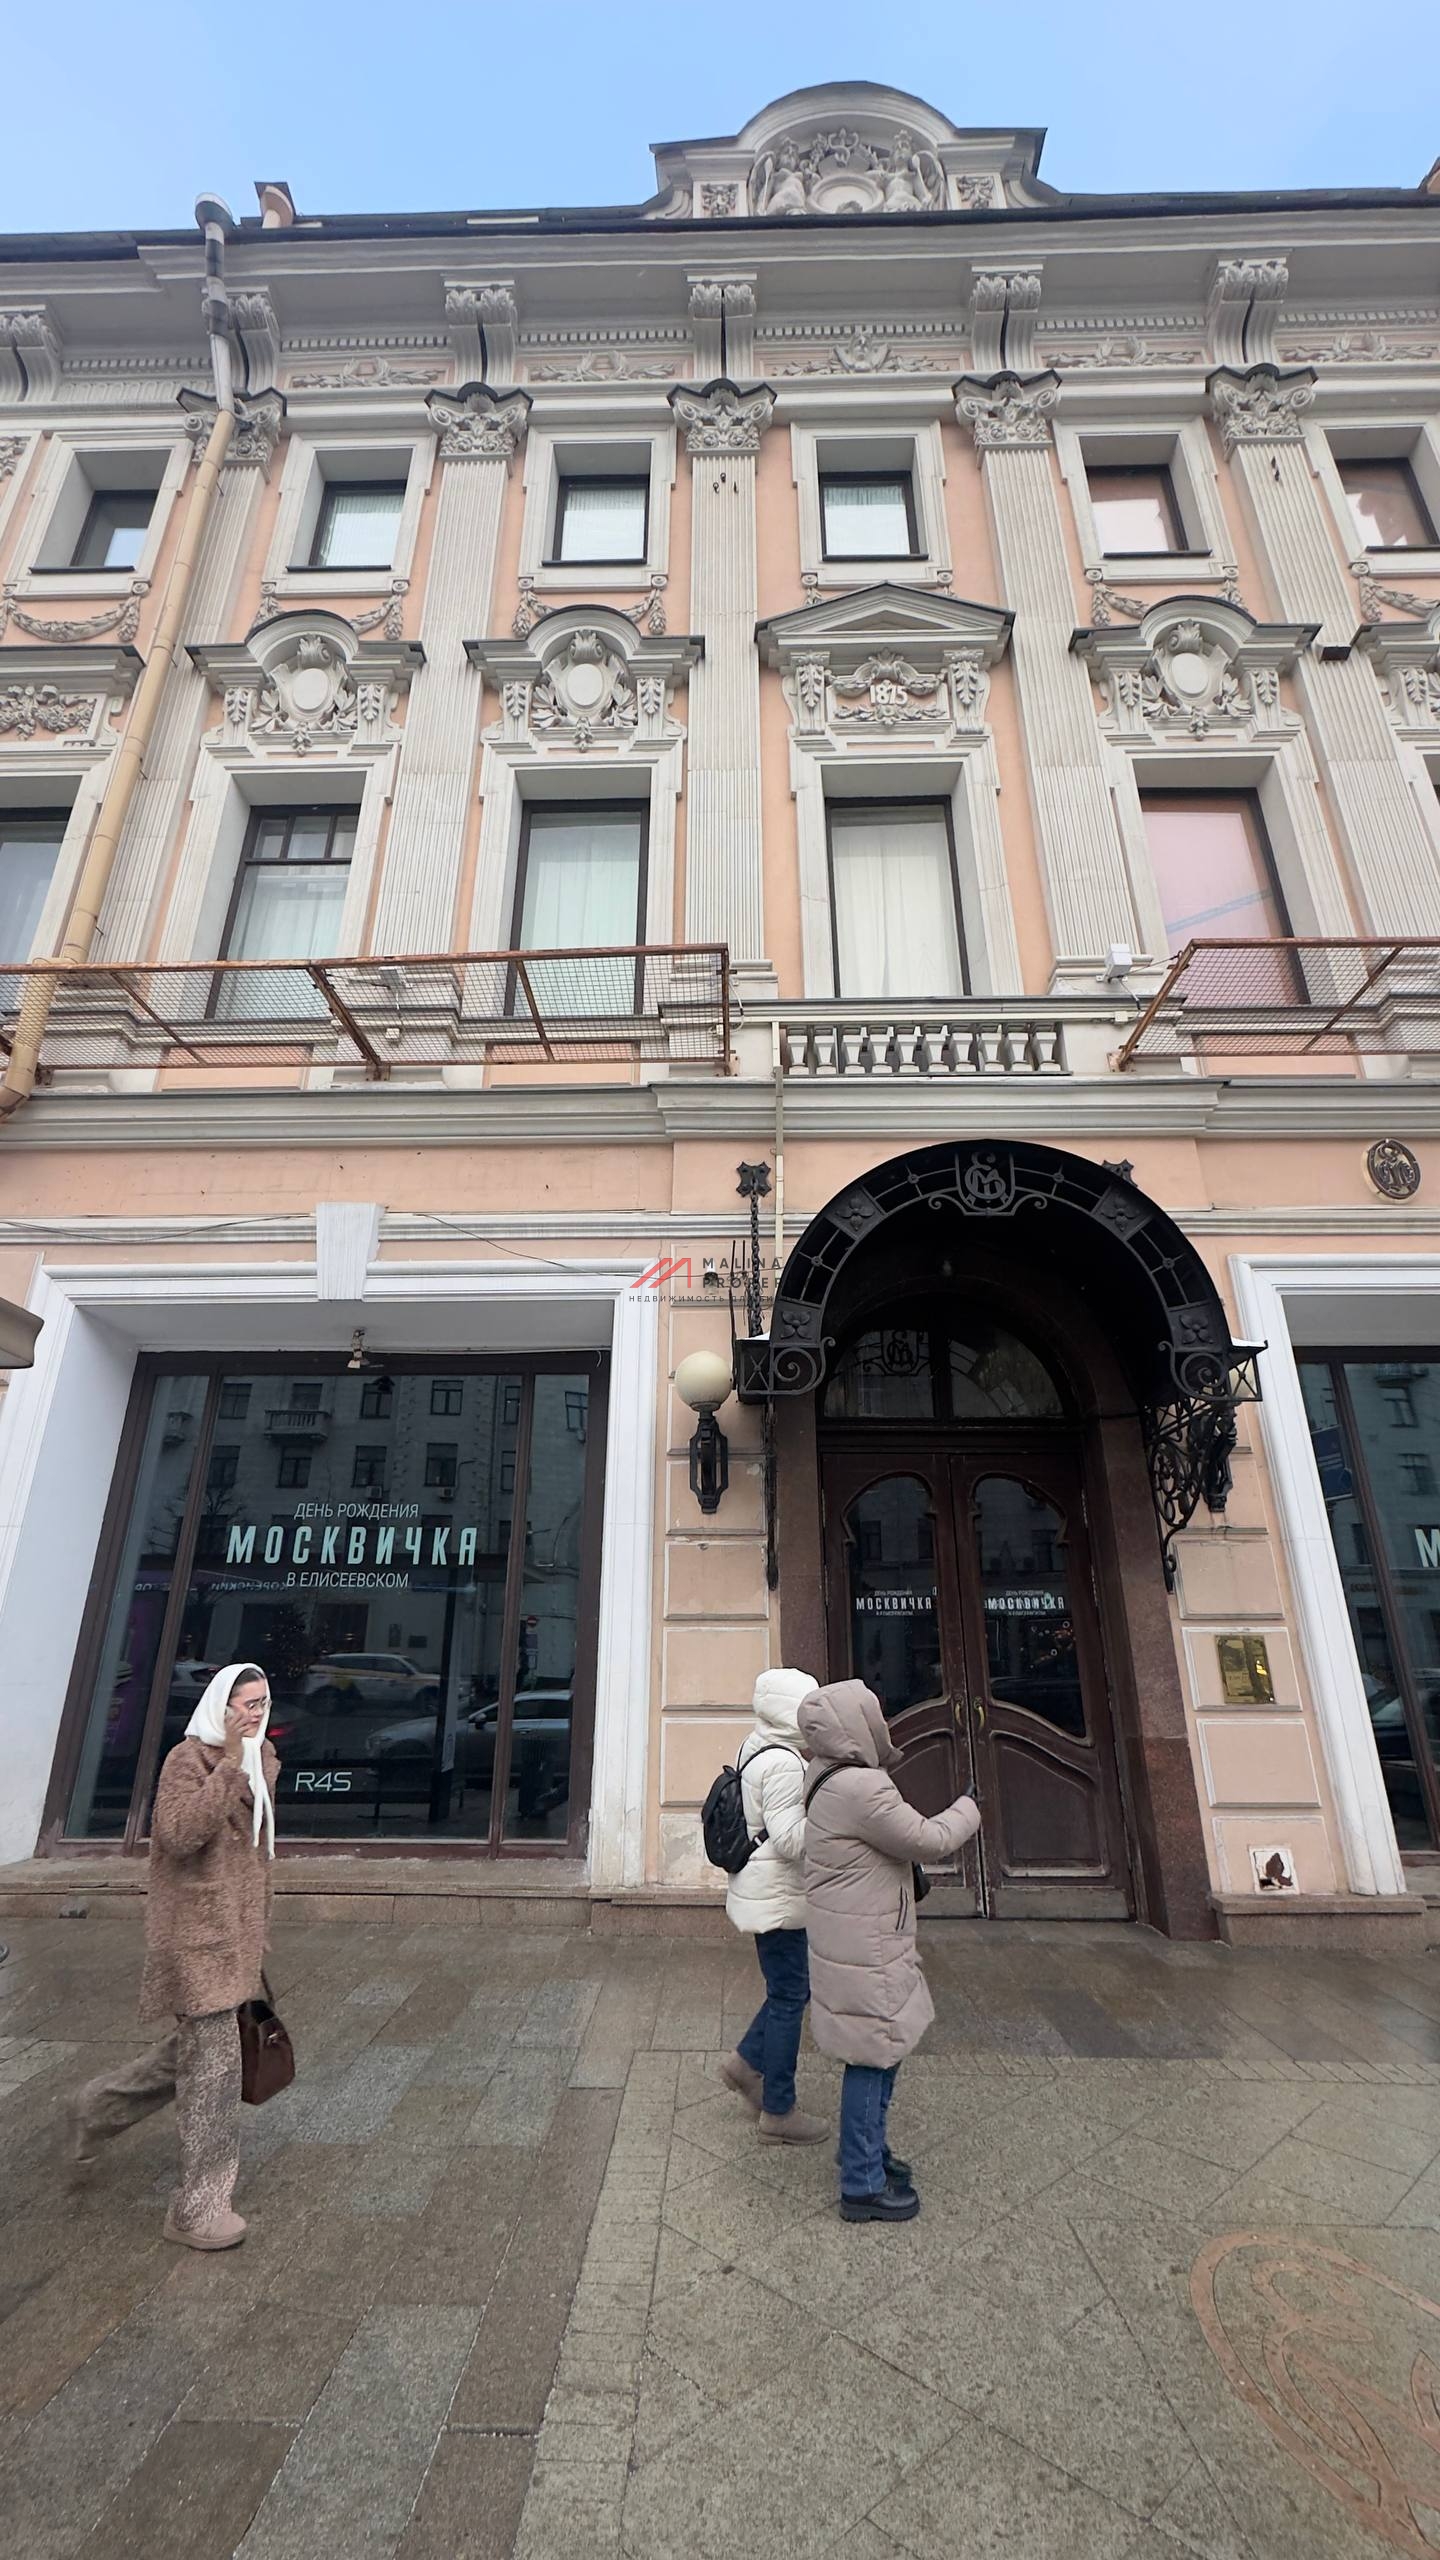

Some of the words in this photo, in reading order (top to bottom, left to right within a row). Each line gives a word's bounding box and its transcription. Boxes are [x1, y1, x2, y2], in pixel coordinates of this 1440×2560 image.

[294, 1503, 333, 1519] ДЕНЬ
[337, 1504, 419, 1519] РОЖДЕНИЯ
[226, 1525, 478, 1566] МОСКВИЧКА
[286, 1572, 296, 1587] В
[300, 1572, 409, 1588] ЕЛИСЕЕВСКОМ
[856, 1597, 932, 1610] МОСКВИЧКА
[295, 1772, 352, 1792] R4S
